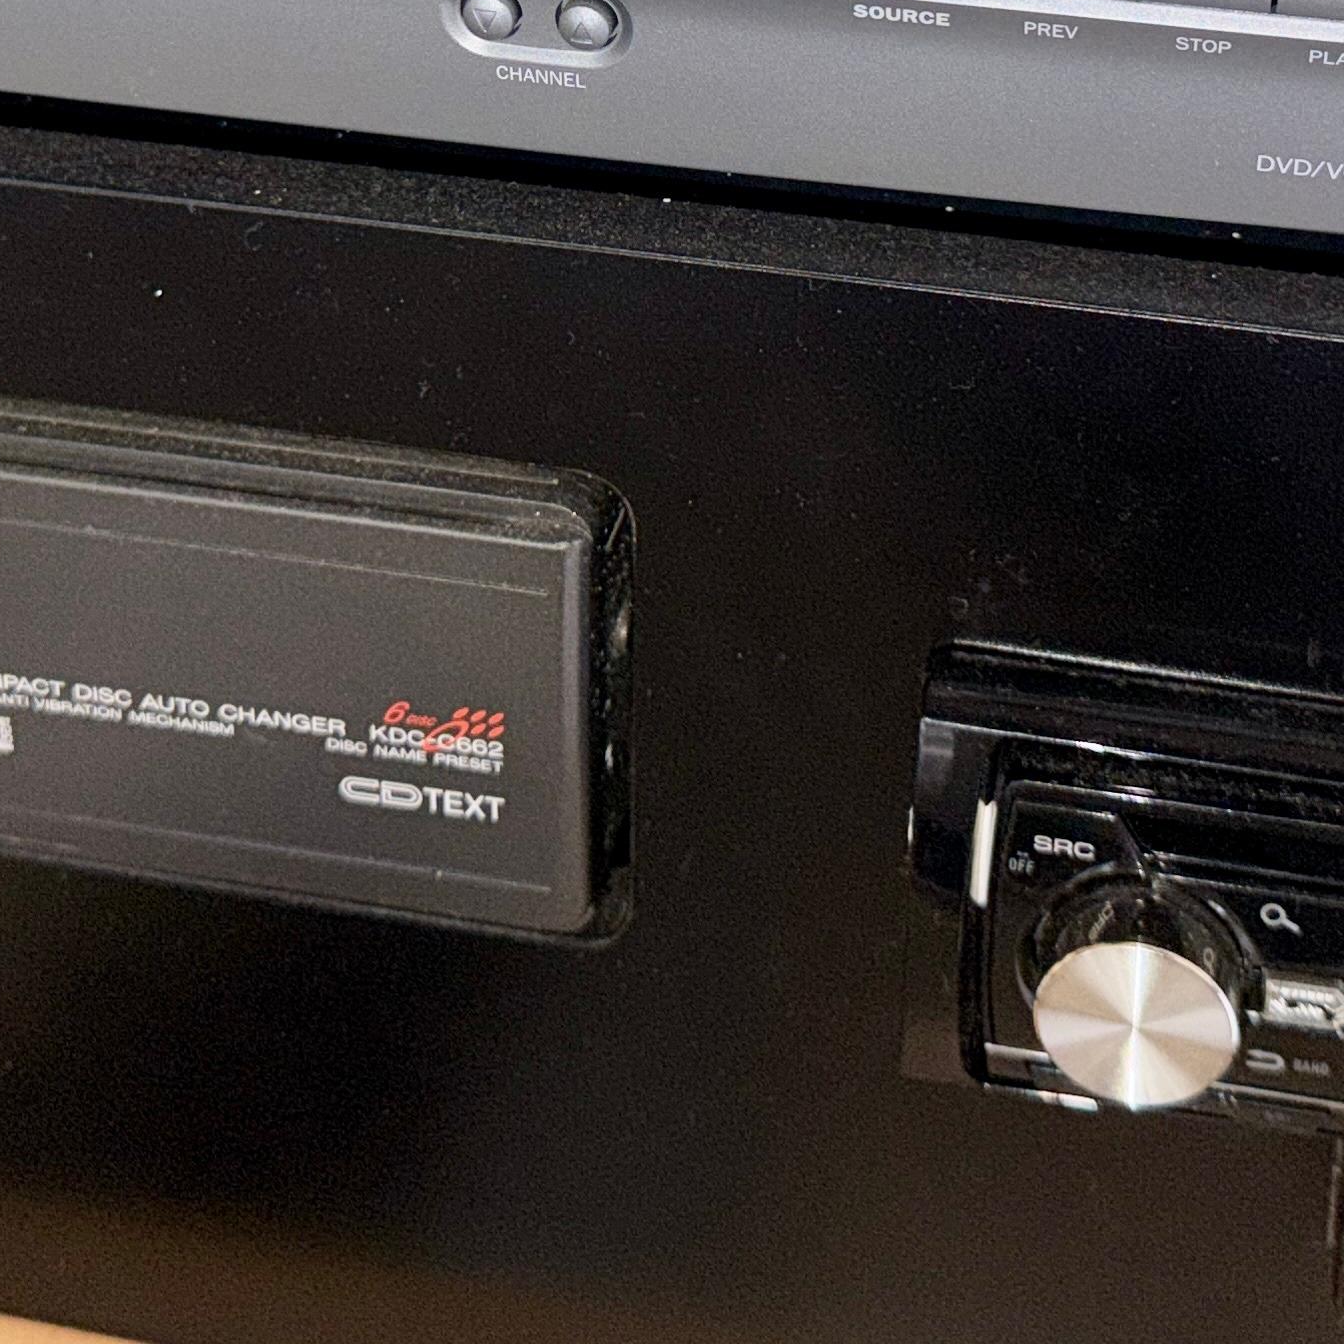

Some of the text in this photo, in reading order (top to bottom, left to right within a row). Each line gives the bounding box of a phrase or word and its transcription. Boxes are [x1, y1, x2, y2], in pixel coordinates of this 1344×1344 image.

[852, 2, 952, 27] SOURCE
[1022, 19, 1080, 41] PREV
[1174, 35, 1233, 56] STOP
[495, 64, 587, 90] CHANNEL
[32, 696, 124, 723] VIBRATION
[128, 709, 236, 738] MECHANISM
[71, 681, 134, 709] DISC
[141, 692, 210, 719] AUTO
[217, 702, 347, 738] CHANGER
[383, 701, 410, 725] 6
[324, 736, 505, 775] DISC NAME PRESET
[1033, 834, 1096, 862] SRC
